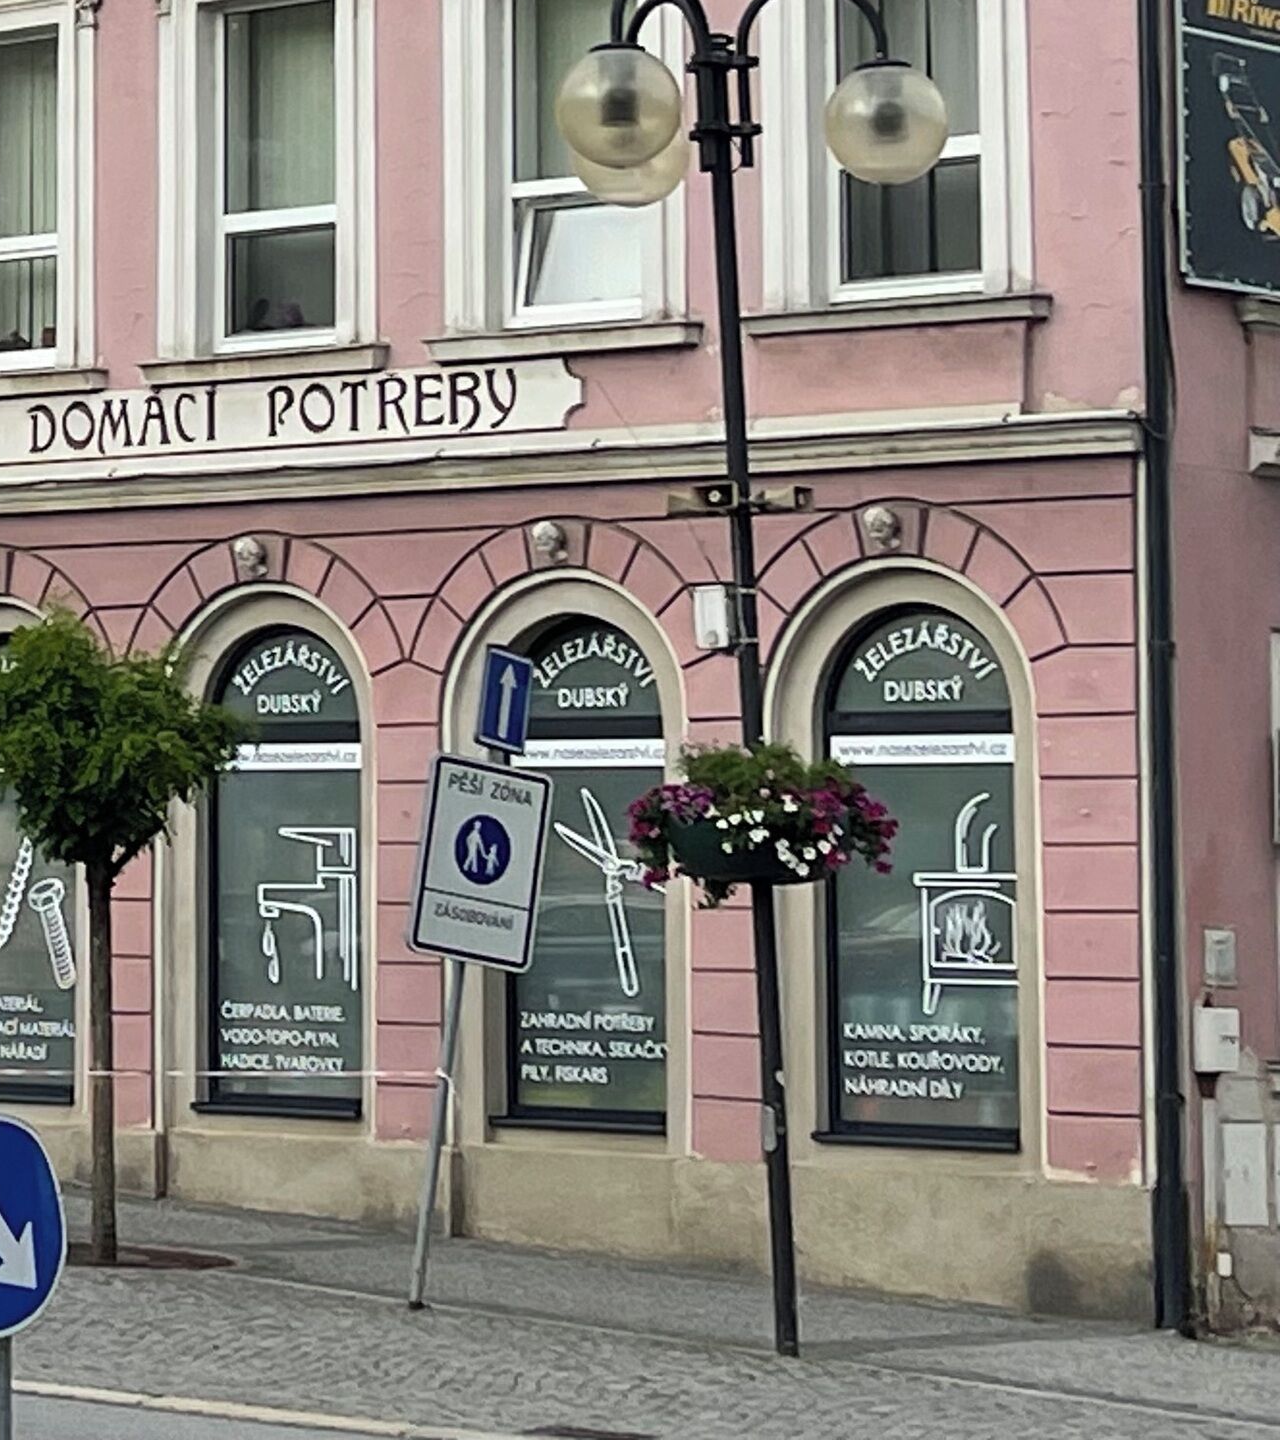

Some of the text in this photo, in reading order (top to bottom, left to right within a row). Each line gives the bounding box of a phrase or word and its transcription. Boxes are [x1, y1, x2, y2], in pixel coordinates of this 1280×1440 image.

[267, 368, 517, 436] POTŘEBY
[532, 631, 657, 688] ŽELEZÁŘSTVÍ
[853, 620, 999, 682] ŽELEZÁŘSTVÍ
[232, 640, 351, 695] ŽELEZÁŘSTVÍ
[257, 689, 322, 713] DUBSKÝ
[557, 682, 629, 708] DUBSKÝ
[883, 675, 964, 702] DUBSKÝ
[448, 771, 533, 807] PĚŠÍ ZÓNA
[520, 1010, 592, 1030] ZAHRADNÍ
[520, 1039, 533, 1054] A
[555, 1064, 608, 1084] FISKARS
[844, 1074, 965, 1100] NÁHRADNÍ DÍLY
